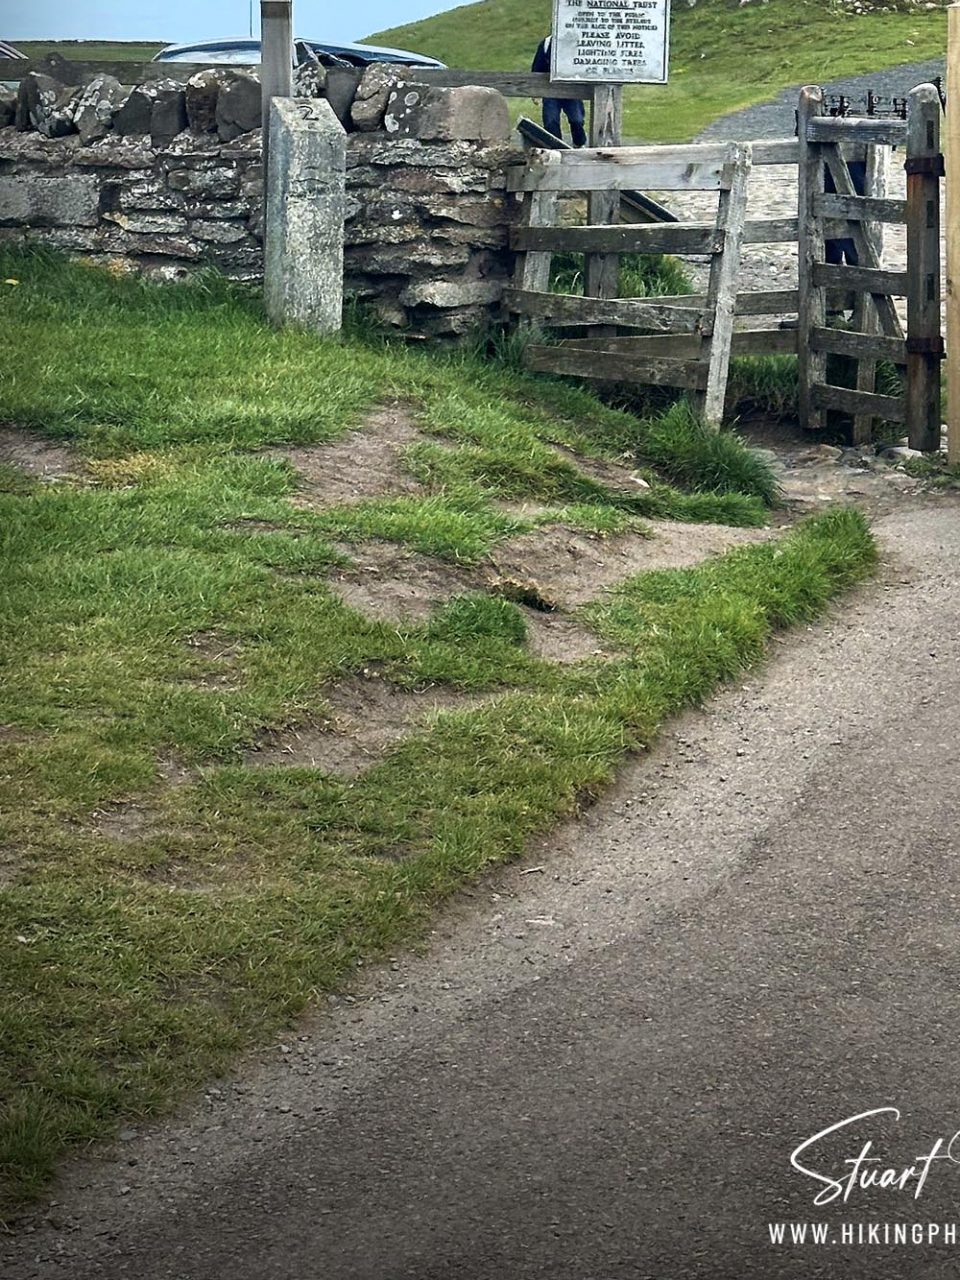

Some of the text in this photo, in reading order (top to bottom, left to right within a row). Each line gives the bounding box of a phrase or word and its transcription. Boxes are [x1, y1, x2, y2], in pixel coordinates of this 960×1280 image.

[566, 0, 658, 9] THE NATIONAL TRUST
[576, 40, 612, 48] LEAVING
[577, 49, 616, 57] LIGHTING
[573, 58, 618, 66] DAMAGING
[297, 105, 319, 121] 2
